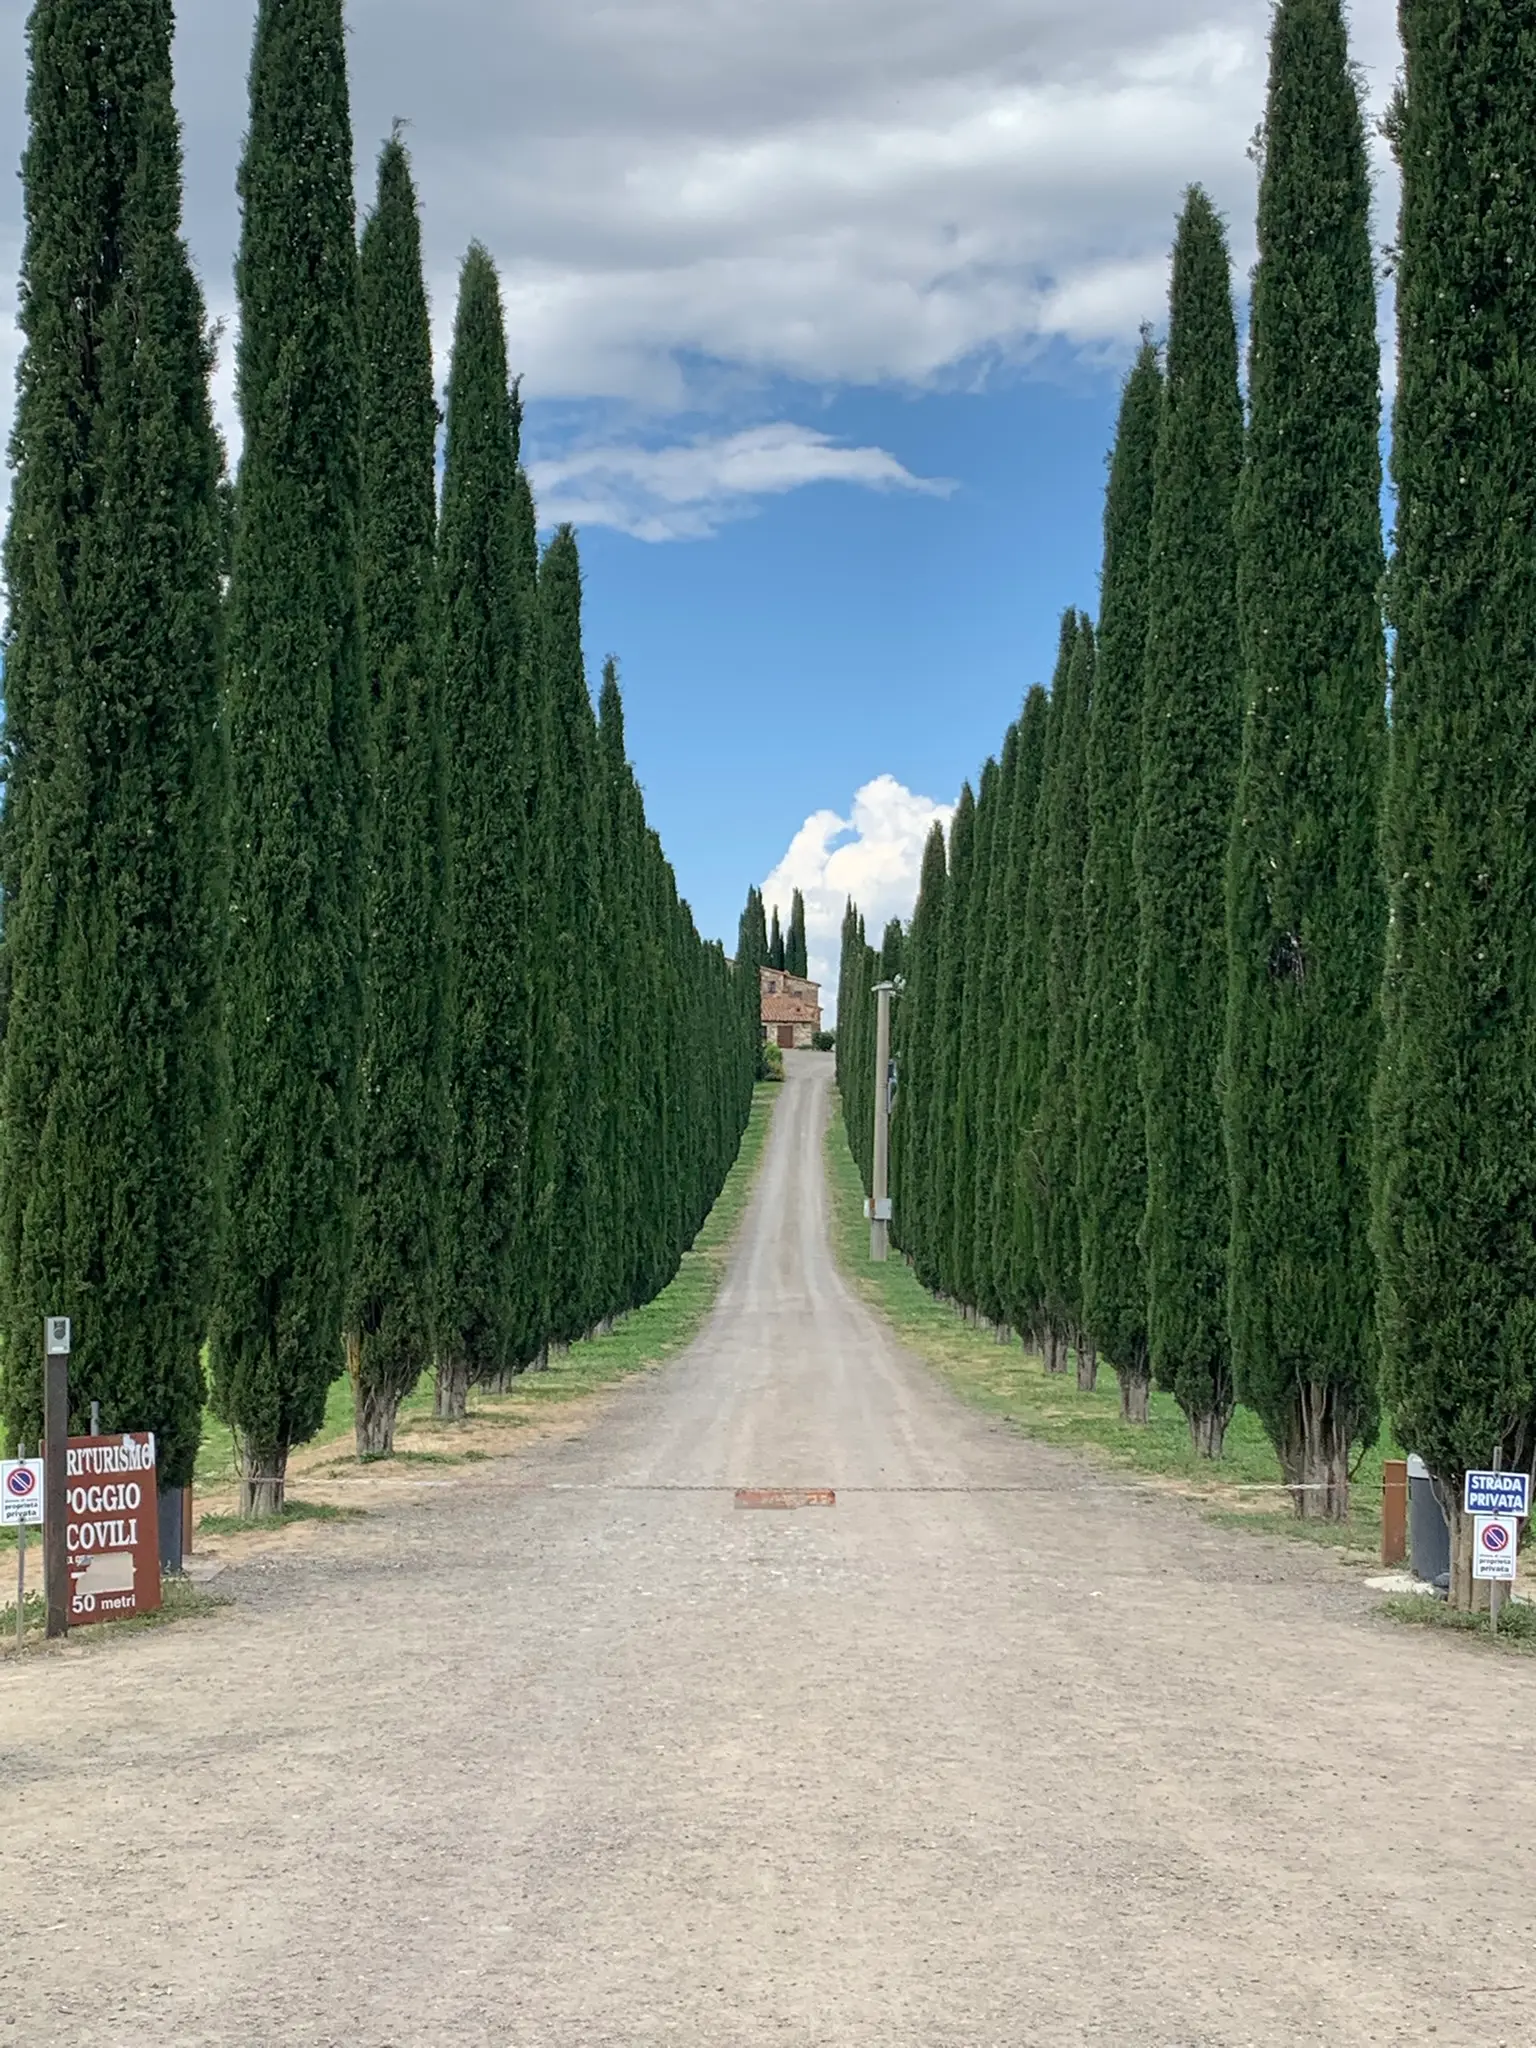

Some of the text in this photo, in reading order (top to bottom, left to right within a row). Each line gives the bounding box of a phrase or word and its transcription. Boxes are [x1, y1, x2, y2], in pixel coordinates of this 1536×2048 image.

[66, 1443, 152, 1476] RITURISMO
[1471, 1475, 1523, 1493] STRADA
[1470, 1492, 1523, 1509] PRIVATA
[6, 1509, 37, 1519] privata
[66, 1518, 138, 1551] COVILI
[72, 1593, 136, 1613] 50 metri
